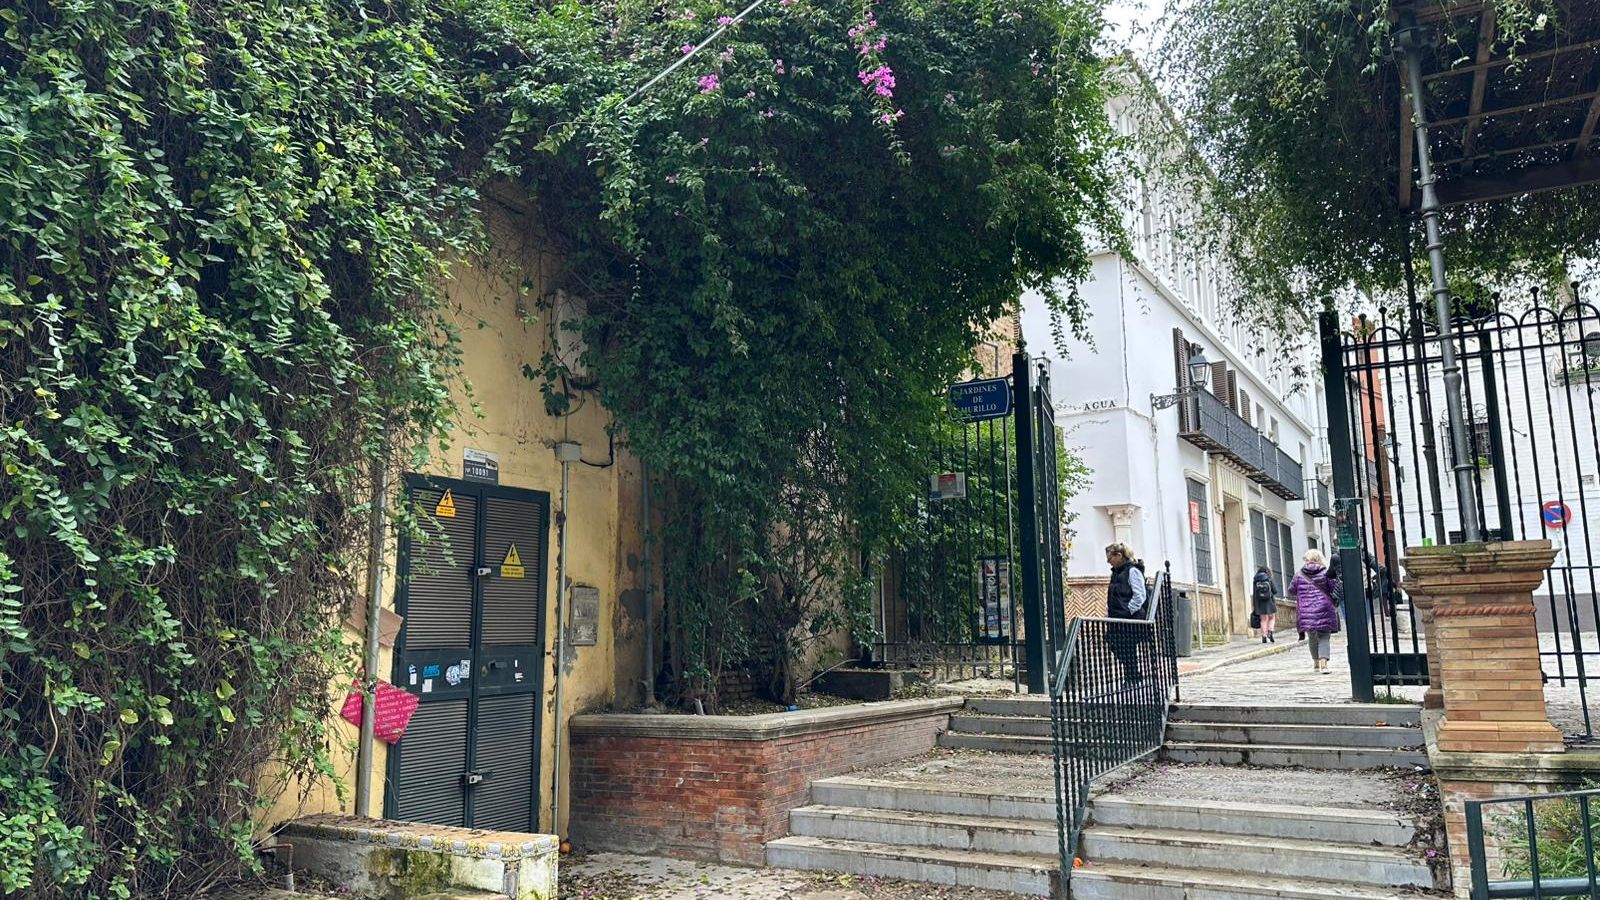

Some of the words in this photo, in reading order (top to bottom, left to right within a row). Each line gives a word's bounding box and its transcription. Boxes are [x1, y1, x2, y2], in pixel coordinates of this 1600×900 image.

[960, 384, 997, 395] JARDINES
[972, 395, 984, 404] DE
[1083, 399, 1116, 411] AGUA
